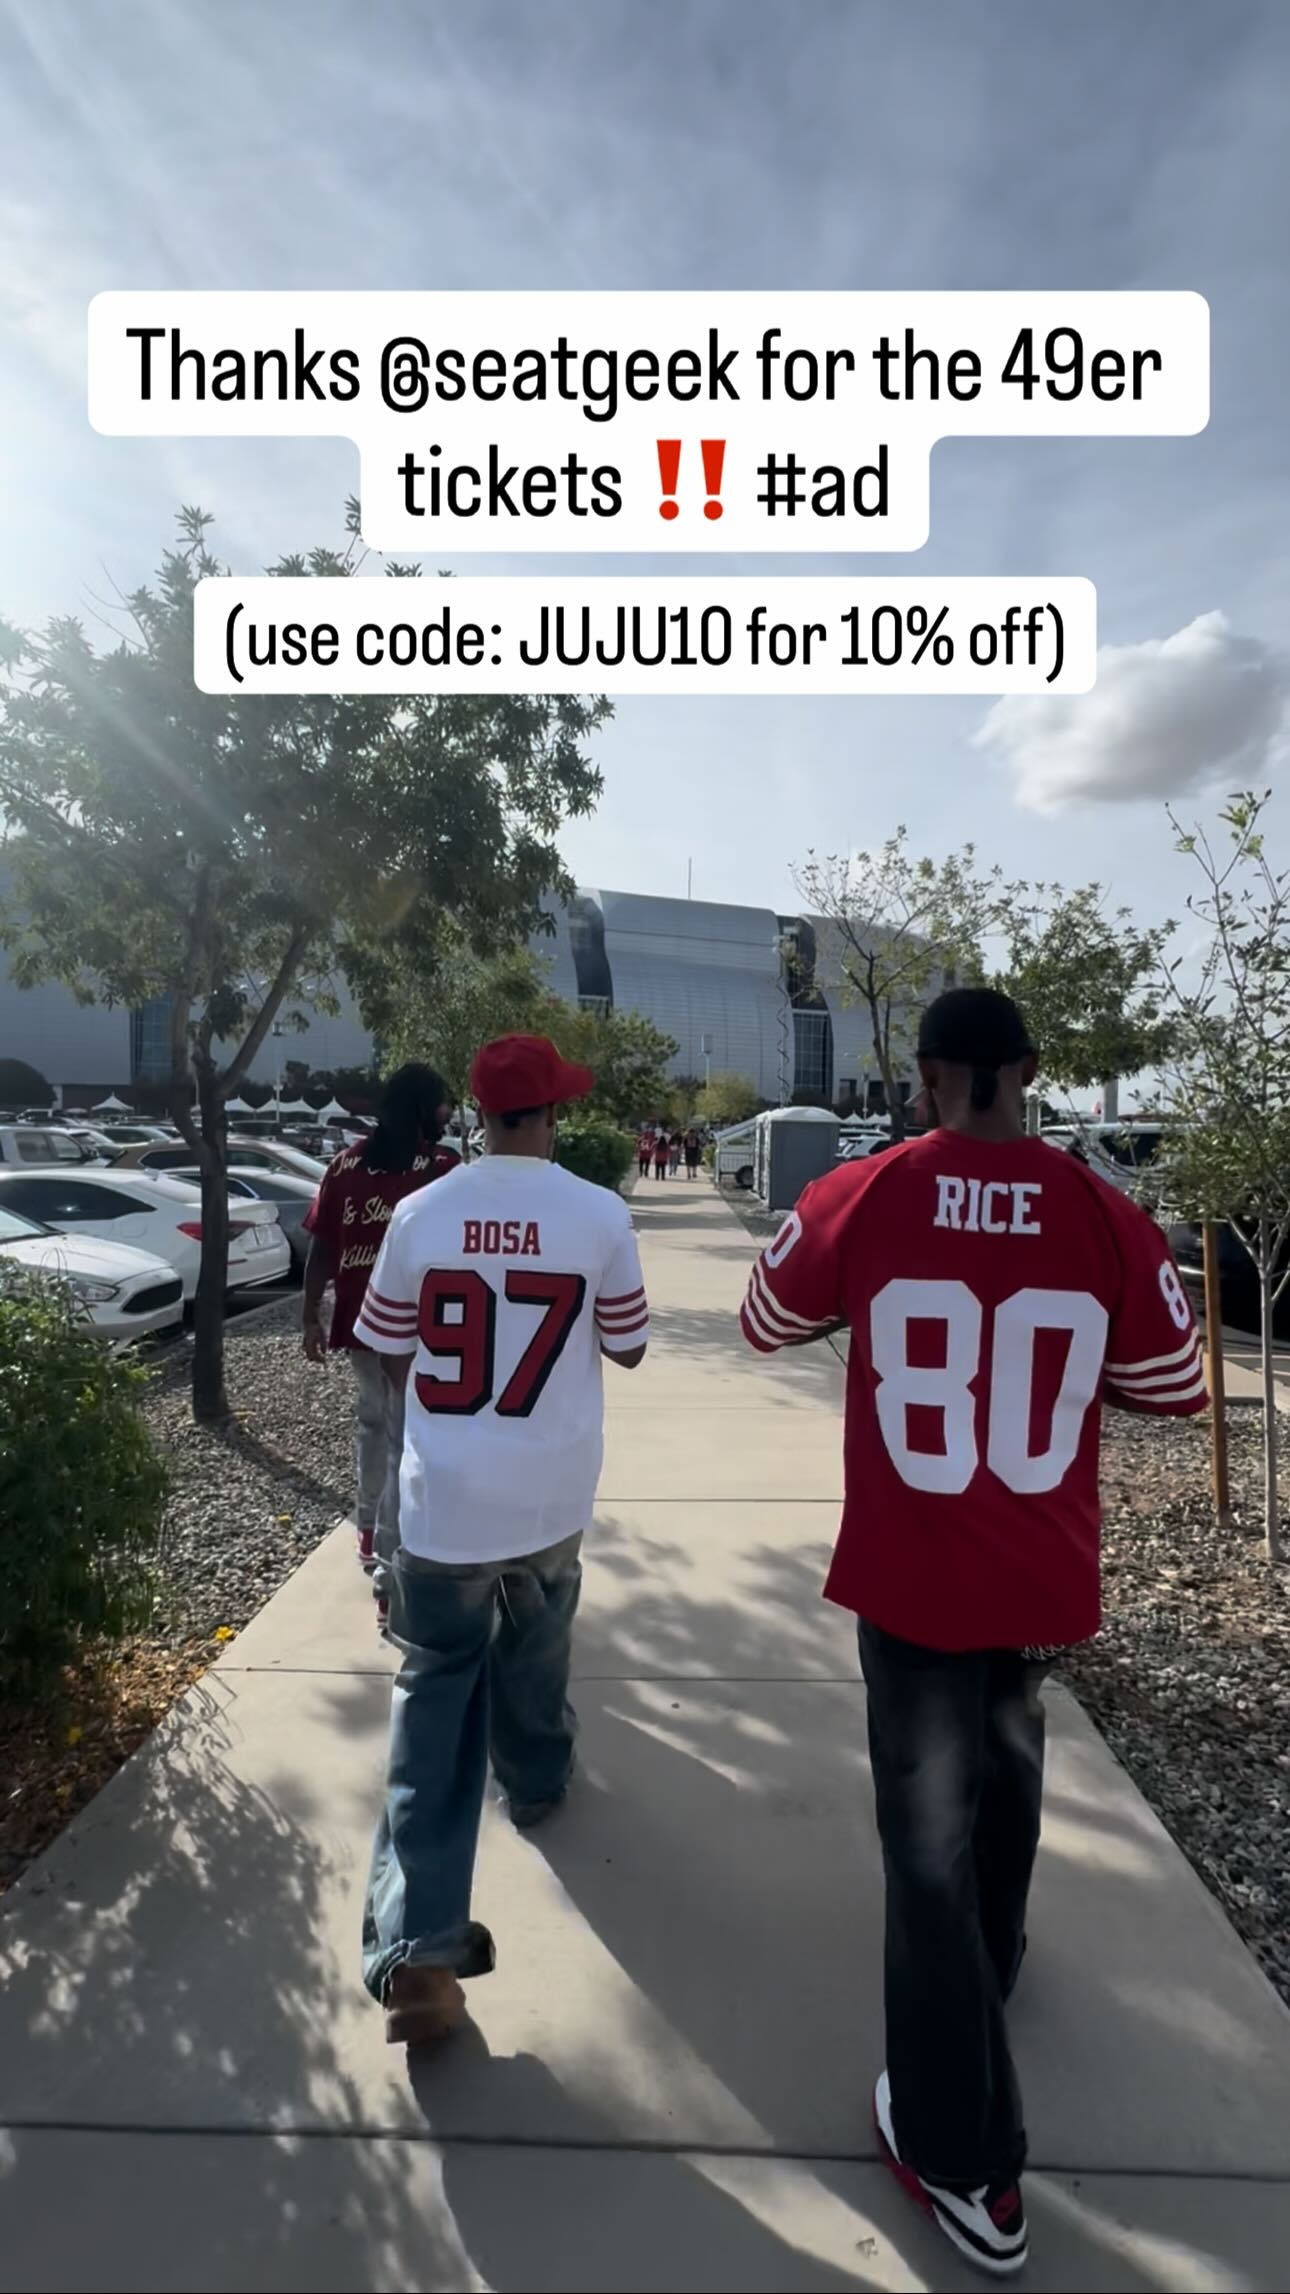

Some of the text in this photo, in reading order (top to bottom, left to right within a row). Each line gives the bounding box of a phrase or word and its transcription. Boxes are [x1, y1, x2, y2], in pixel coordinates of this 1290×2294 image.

[463, 1220, 541, 1256] BOSA
[933, 1175, 1042, 1235] RICE
[764, 1210, 802, 1268] 0
[1158, 1259, 1191, 1331] 8
[415, 1268, 586, 1418] 97
[870, 1278, 1109, 1494] 80
